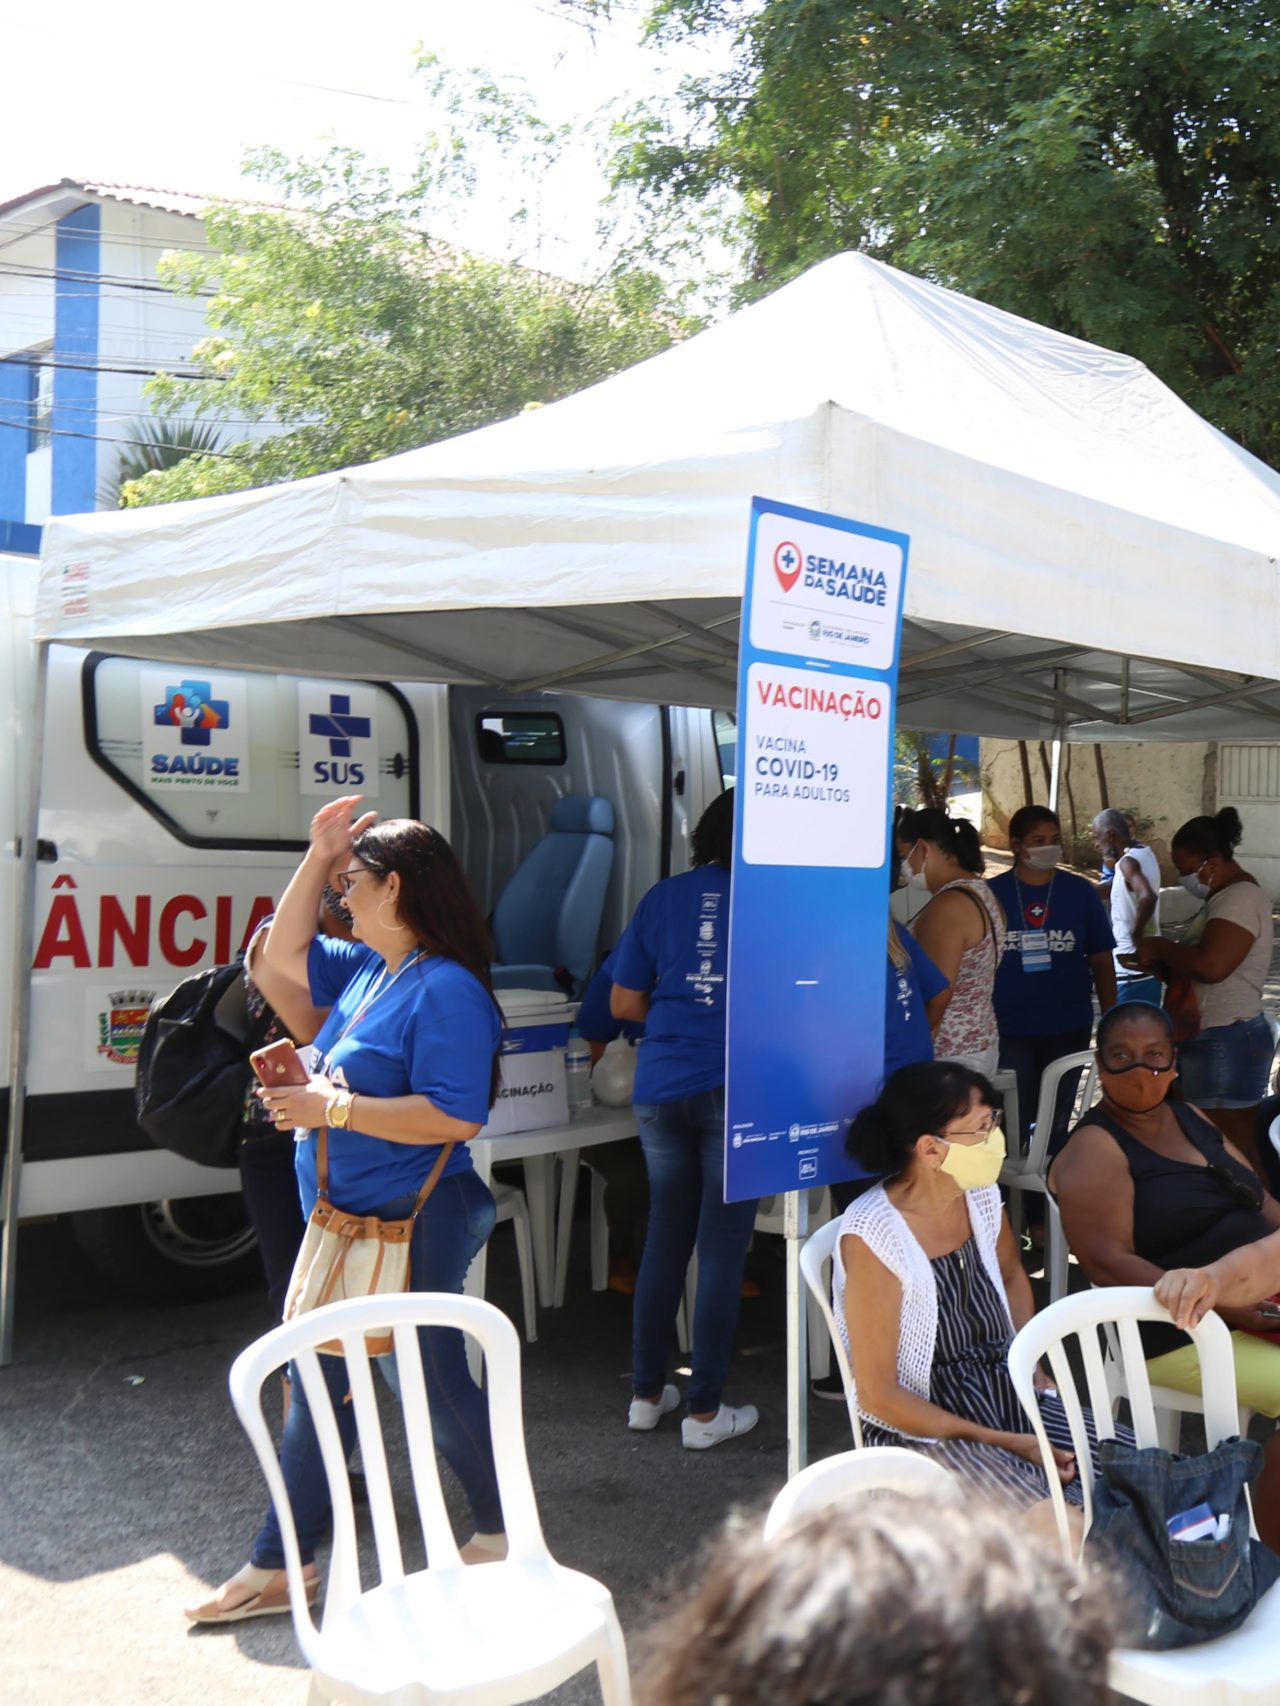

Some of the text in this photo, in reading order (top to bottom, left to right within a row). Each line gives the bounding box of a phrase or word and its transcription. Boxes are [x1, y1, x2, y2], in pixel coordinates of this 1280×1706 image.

[807, 555, 887, 588] SEMANA
[757, 680, 882, 721] VACINAÇÃO
[756, 735, 806, 754] VACINA
[151, 752, 239, 776] SAÚDE
[313, 761, 365, 786] SUS
[756, 756, 839, 782] COVID-19
[755, 782, 850, 803] PARA ADULTOS
